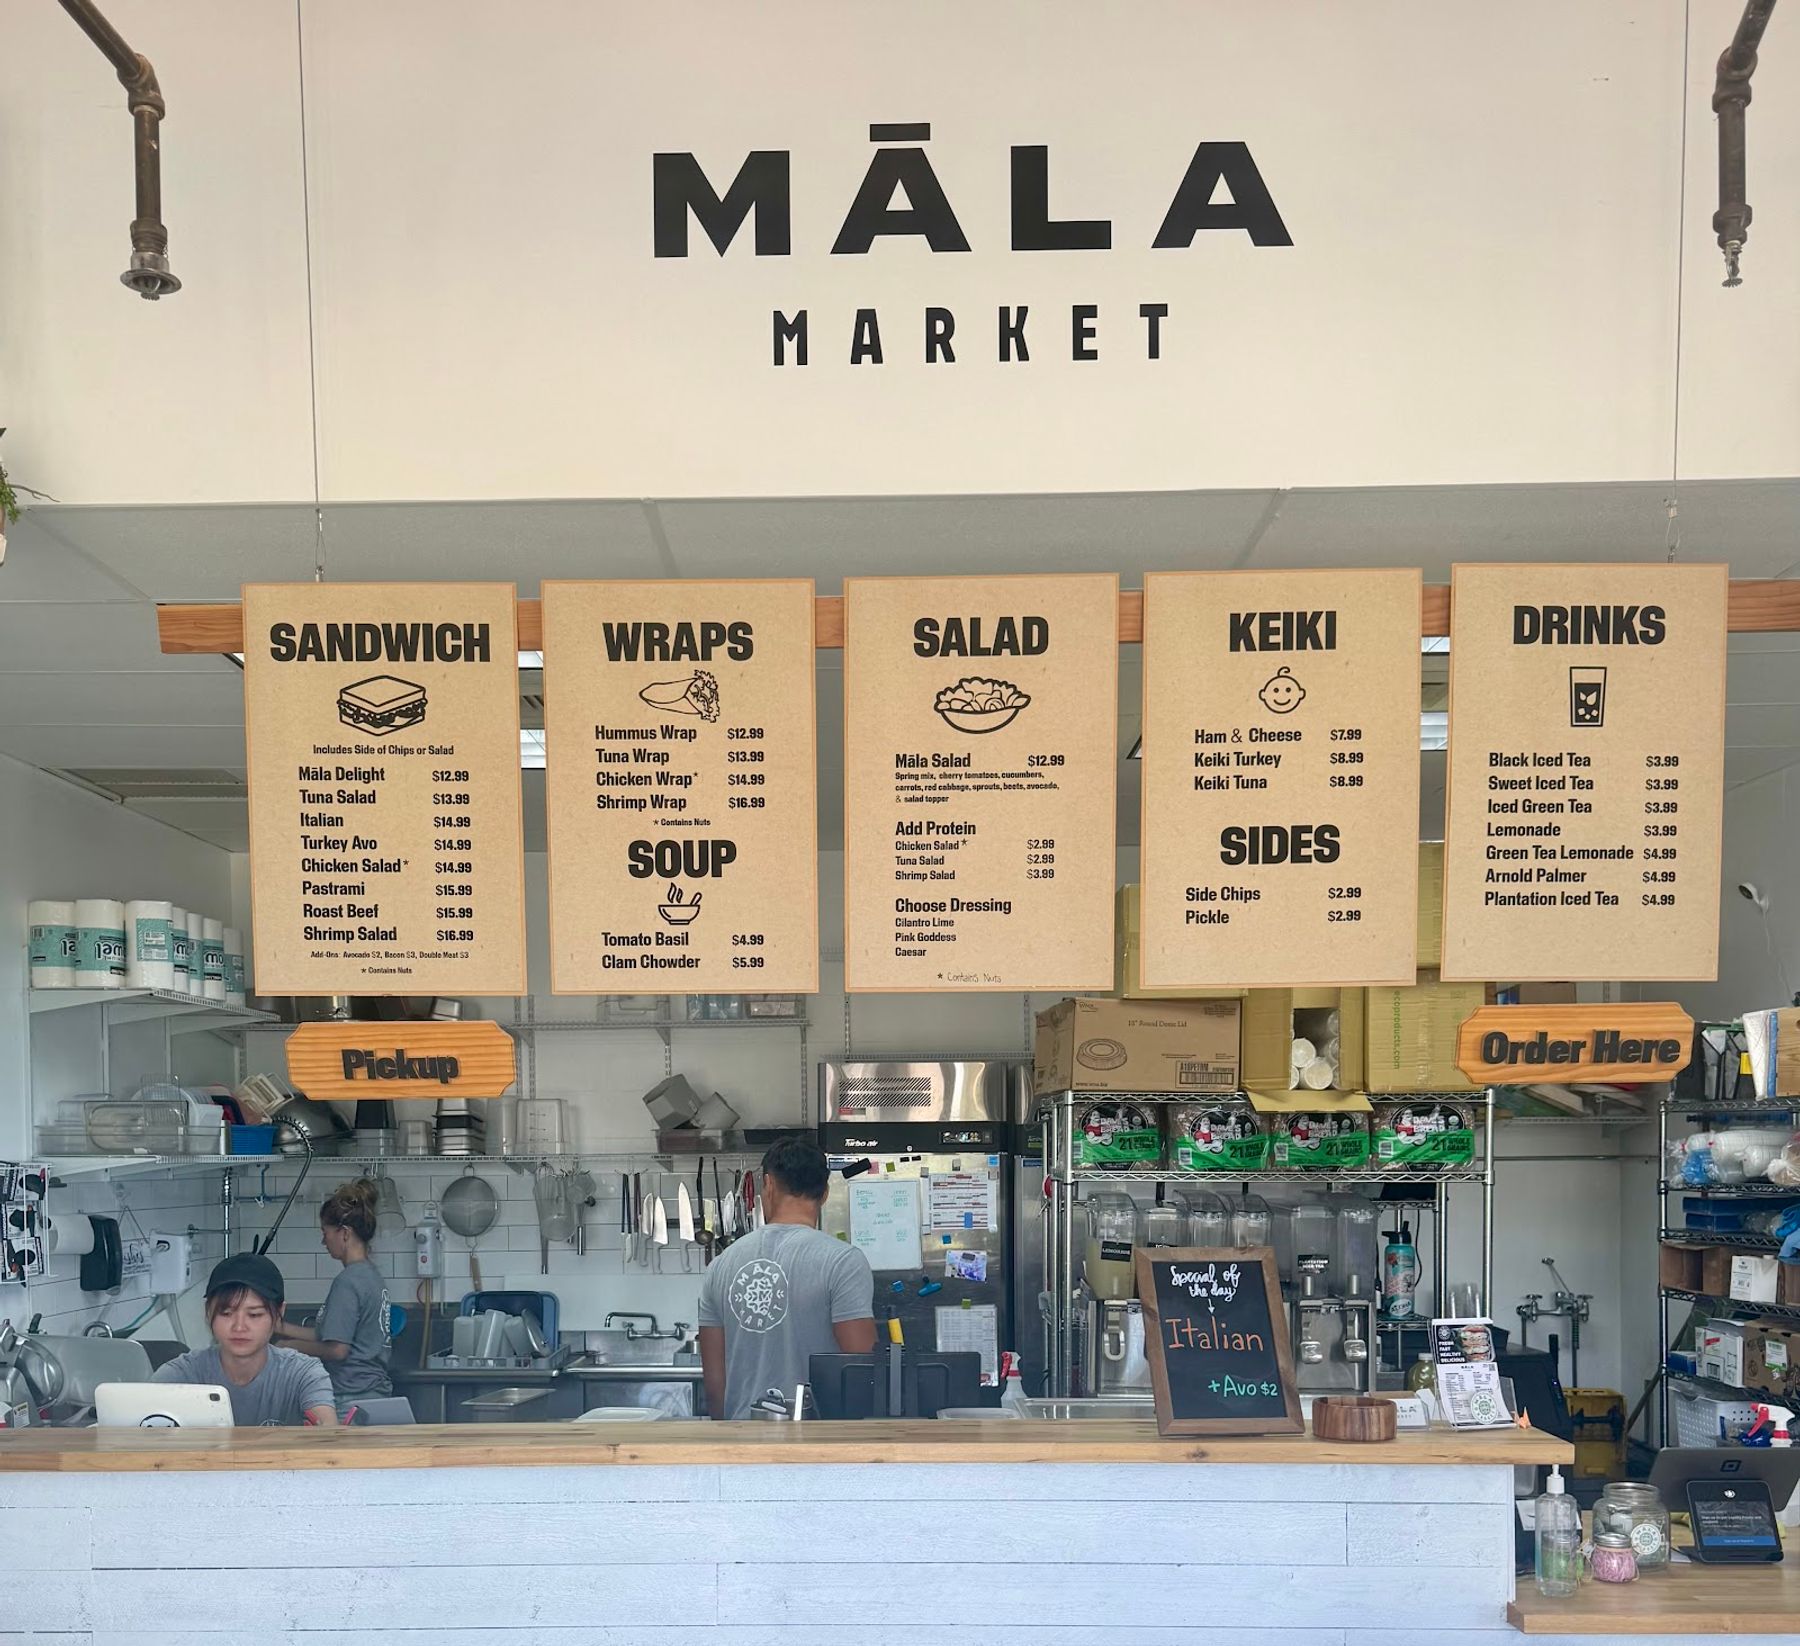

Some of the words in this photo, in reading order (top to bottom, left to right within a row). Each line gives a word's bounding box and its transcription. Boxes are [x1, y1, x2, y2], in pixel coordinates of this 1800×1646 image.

[653, 123, 1294, 258] MĀLA
[773, 304, 1168, 366] MARKET
[1230, 611, 1336, 652] KEIKI
[1514, 606, 1665, 644] DRINKS
[270, 623, 490, 662] SANDWICH
[602, 622, 753, 661] WRAPS
[914, 616, 1048, 657] SALAD
[596, 726, 656, 740] Hummus
[660, 725, 696, 742] Wrap
[728, 728, 764, 740] $12.99
[1195, 729, 1226, 743] Ham
[1231, 728, 1242, 743] &
[1249, 728, 1302, 742] Cheese
[1330, 729, 1361, 741] $7.99
[314, 745, 352, 754] Includes
[355, 745, 375, 754] Side
[377, 745, 386, 754] of
[388, 745, 414, 756] Chips
[428, 745, 454, 754] Salad
[596, 749, 629, 762] Tuna
[633, 748, 669, 766] Wrap
[728, 751, 764, 762] $13.99
[896, 754, 928, 768] Māla
[932, 753, 970, 767] Salad
[1028, 755, 1064, 767] $12.99
[1195, 752, 1229, 767] Keiki
[1234, 752, 1281, 768] Turkey
[1330, 752, 1363, 764] $8.99
[1490, 753, 1528, 766] Black
[1533, 752, 1562, 766] Iced
[1567, 753, 1590, 766] Tea
[1646, 756, 1678, 767] $3.99
[299, 766, 331, 780] Māla
[336, 767, 384, 784] Delight
[432, 770, 469, 782] $12.99
[597, 772, 652, 786] Chicken
[728, 774, 764, 785] $14.99
[896, 772, 919, 781] Spring
[1195, 776, 1229, 790] Keiki
[1233, 775, 1267, 789] Tuna
[1330, 776, 1363, 787] $8.99
[1489, 776, 1532, 790] Sweet
[1536, 776, 1566, 790] Iced
[1570, 776, 1593, 790] Tea
[1646, 779, 1678, 790] $3.99
[299, 790, 332, 804] Tuna
[337, 790, 376, 804] Salad
[433, 793, 469, 804] $13.99
[597, 795, 646, 812] Shrimp
[650, 794, 686, 812] Wrap
[729, 797, 765, 809] $16.99
[925, 796, 949, 804] topper
[1488, 799, 1518, 813] Iced
[1522, 799, 1564, 813] Green
[1568, 799, 1592, 813] Tea
[1645, 802, 1677, 813] $3.99
[301, 813, 343, 826] Italian
[434, 816, 470, 828] $14.99
[661, 818, 692, 826] Contains
[896, 821, 922, 835] Add
[926, 821, 976, 835] Protein
[1488, 822, 1560, 836] Lemonade
[1644, 825, 1676, 836] $3.99
[301, 835, 348, 852] Turkey
[352, 836, 377, 850] Avo
[434, 839, 471, 850] $14.99
[896, 841, 931, 850] Chicken
[1027, 840, 1054, 850] $2.99
[1220, 824, 1340, 865] SIDES
[628, 840, 736, 878] SOUP
[896, 856, 916, 865] Tuna
[920, 856, 944, 865] Salad
[1027, 854, 1054, 864] $2.99
[1487, 845, 1528, 859] Green
[1532, 845, 1556, 859] Tea
[1561, 845, 1633, 859] Lemonade
[1644, 848, 1676, 860] $4.99
[302, 858, 358, 872] Chicken
[436, 862, 472, 873] $14.99
[896, 871, 928, 882] Shrimp
[930, 870, 955, 879] Salad
[1027, 869, 1054, 879] $3.99
[1486, 868, 1532, 882] Arnold
[1537, 868, 1586, 882] Palmer
[1643, 872, 1675, 883] $4.99
[303, 881, 364, 895] Pastrami
[436, 885, 472, 896] $15.99
[1186, 887, 1217, 901] Side
[1221, 886, 1260, 903] Chips
[1328, 887, 1361, 899] $2.99
[896, 898, 946, 912] Choose
[951, 898, 1011, 914] Dressing
[1485, 892, 1556, 905] Plantation
[1561, 891, 1591, 905] Iced
[1595, 891, 1618, 905] Tea
[1642, 894, 1675, 906] $4.99
[304, 904, 343, 918] Roast
[347, 904, 378, 918] Beef
[437, 907, 472, 918] $15.99
[1186, 910, 1229, 924] Pickle
[1328, 910, 1361, 922] $2.99
[896, 918, 930, 927] Cilantro
[933, 918, 954, 926] Lime
[304, 926, 354, 943] Shrimp
[358, 926, 397, 940] Salad
[437, 930, 473, 940] $16.99
[602, 932, 651, 946] Tomato
[656, 932, 688, 946] Basil
[732, 935, 764, 946] $4.99
[896, 933, 915, 941] Pink
[918, 932, 956, 941] Goddess
[896, 947, 926, 956] Caesar
[602, 955, 636, 968] Clam
[641, 954, 700, 968] Chowder
[733, 957, 764, 968] $5.99
[1482, 1030, 1587, 1064] Order
[1592, 1029, 1681, 1063] Here
[341, 1048, 460, 1084] Pickup
[1119, 1137, 1133, 1150] 21
[1325, 1142, 1339, 1156] 21
[1431, 1138, 1446, 1151] 21
[1230, 1145, 1243, 1158] 21
[1170, 1263, 1217, 1286] Special
[1222, 1263, 1241, 1287] of
[1188, 1284, 1208, 1297] the
[1210, 1283, 1237, 1302] day
[1165, 1315, 1264, 1351] Italian
[1261, 1381, 1278, 1396] $2
